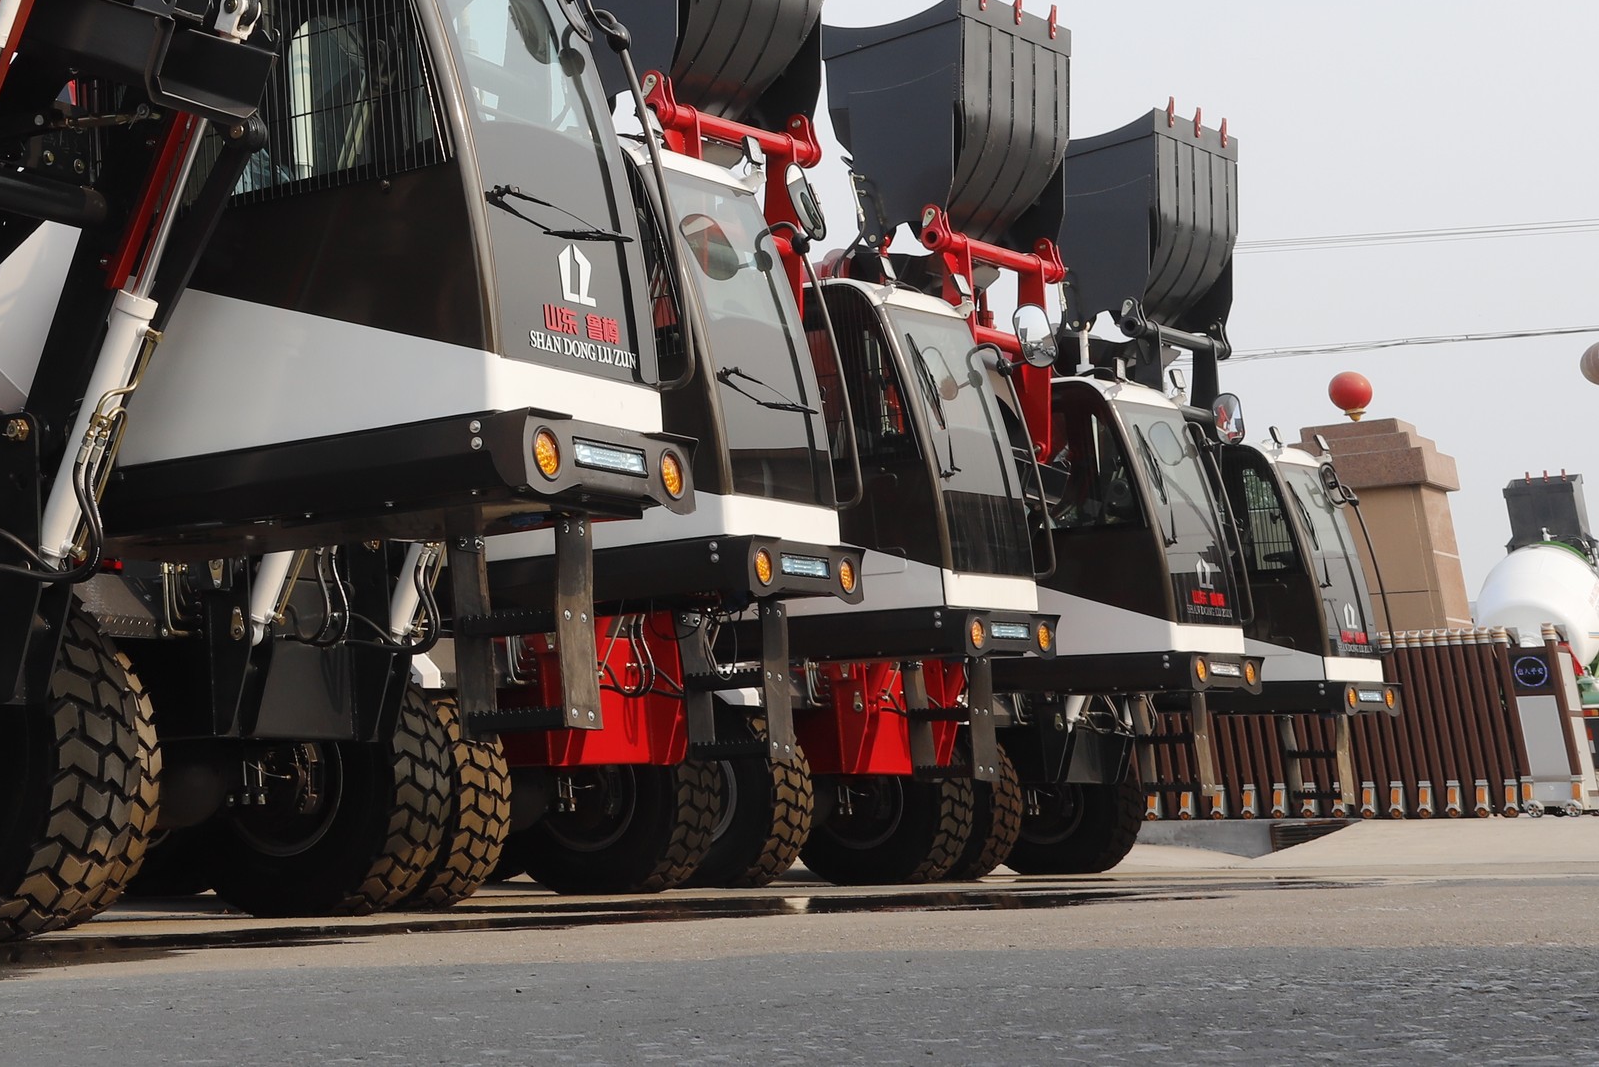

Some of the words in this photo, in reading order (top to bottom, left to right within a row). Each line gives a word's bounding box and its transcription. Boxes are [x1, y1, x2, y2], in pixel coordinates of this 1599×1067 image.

[543, 303, 579, 335] 山东
[529, 329, 561, 354] SHAN
[562, 337, 597, 362] DONG
